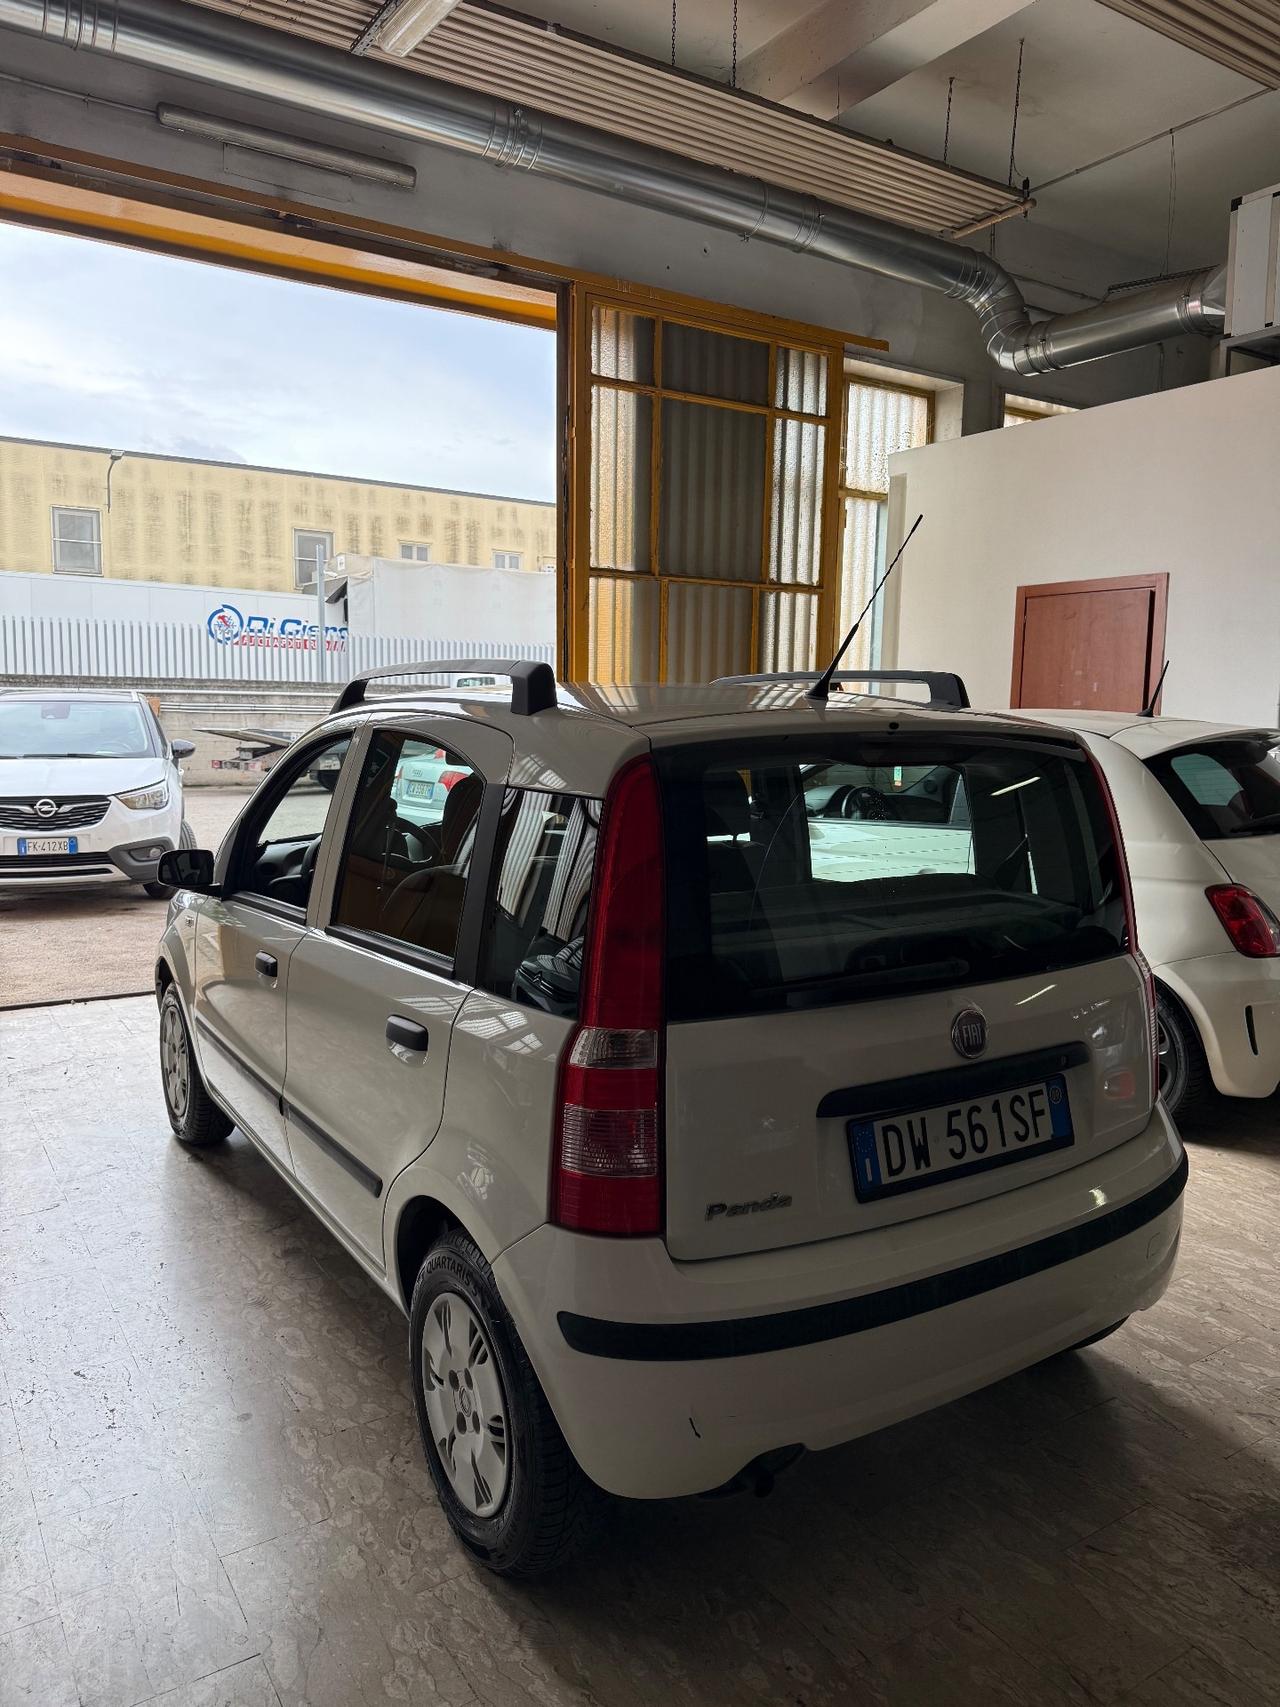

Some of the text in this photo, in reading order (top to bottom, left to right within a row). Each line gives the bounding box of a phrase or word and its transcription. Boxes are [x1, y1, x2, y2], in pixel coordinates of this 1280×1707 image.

[962, 1023, 982, 1047] FIAT
[881, 1117, 931, 1177] DW
[946, 1089, 1045, 1160] 561SF
[705, 1192, 792, 1221] Panda
[426, 1256, 471, 1286] QUARTARIS
